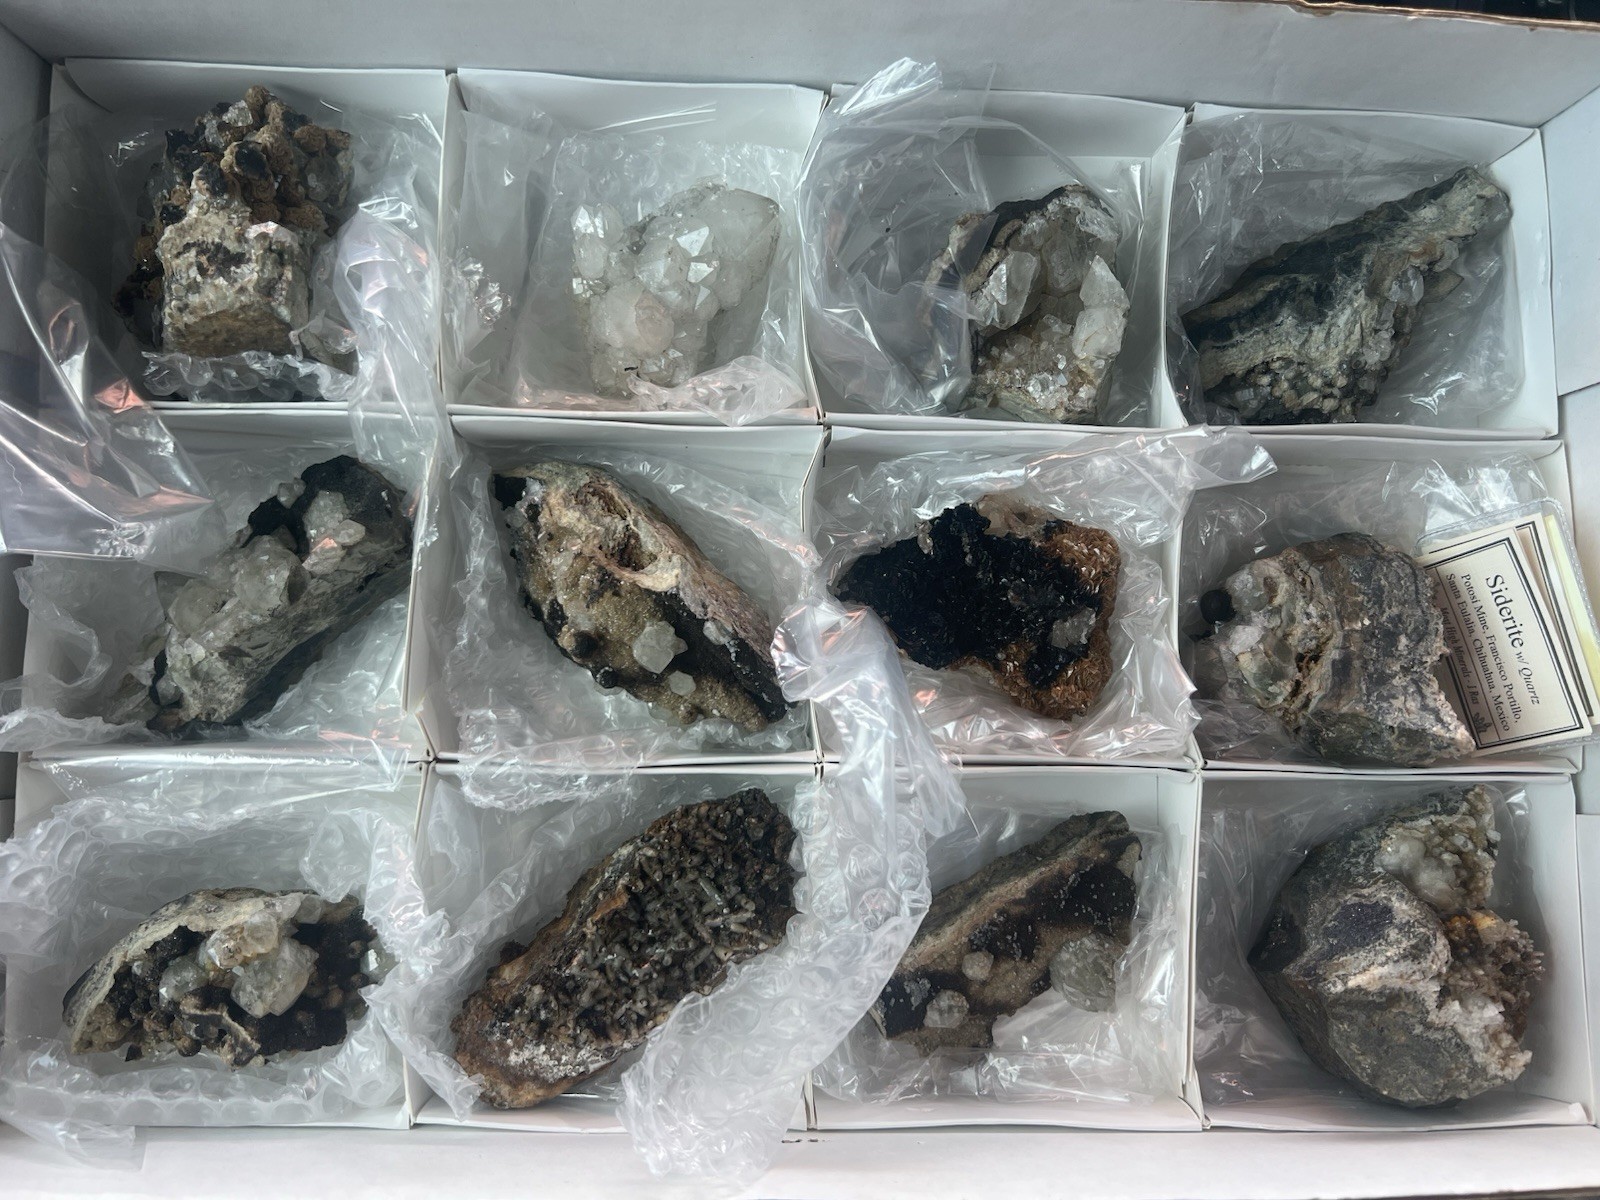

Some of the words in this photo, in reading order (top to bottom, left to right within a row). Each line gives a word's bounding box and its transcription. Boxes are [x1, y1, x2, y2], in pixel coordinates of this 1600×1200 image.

[1485, 574, 1524, 648] Siderite
[1446, 573, 1462, 599] Santa
[1457, 601, 1476, 638] Eulalia,
[1472, 638, 1496, 693] Chihuahua,
[1492, 695, 1510, 732] Mexico
[1446, 626, 1458, 645] High
[1453, 646, 1472, 678] Minerals
[1469, 690, 1479, 705] Ras
[1474, 605, 1490, 634] Mine,
[1486, 634, 1508, 681] Francisco
[1504, 683, 1522, 724] Portillo,
[1515, 652, 1529, 665] w/
[1518, 667, 1540, 705] Quartz
